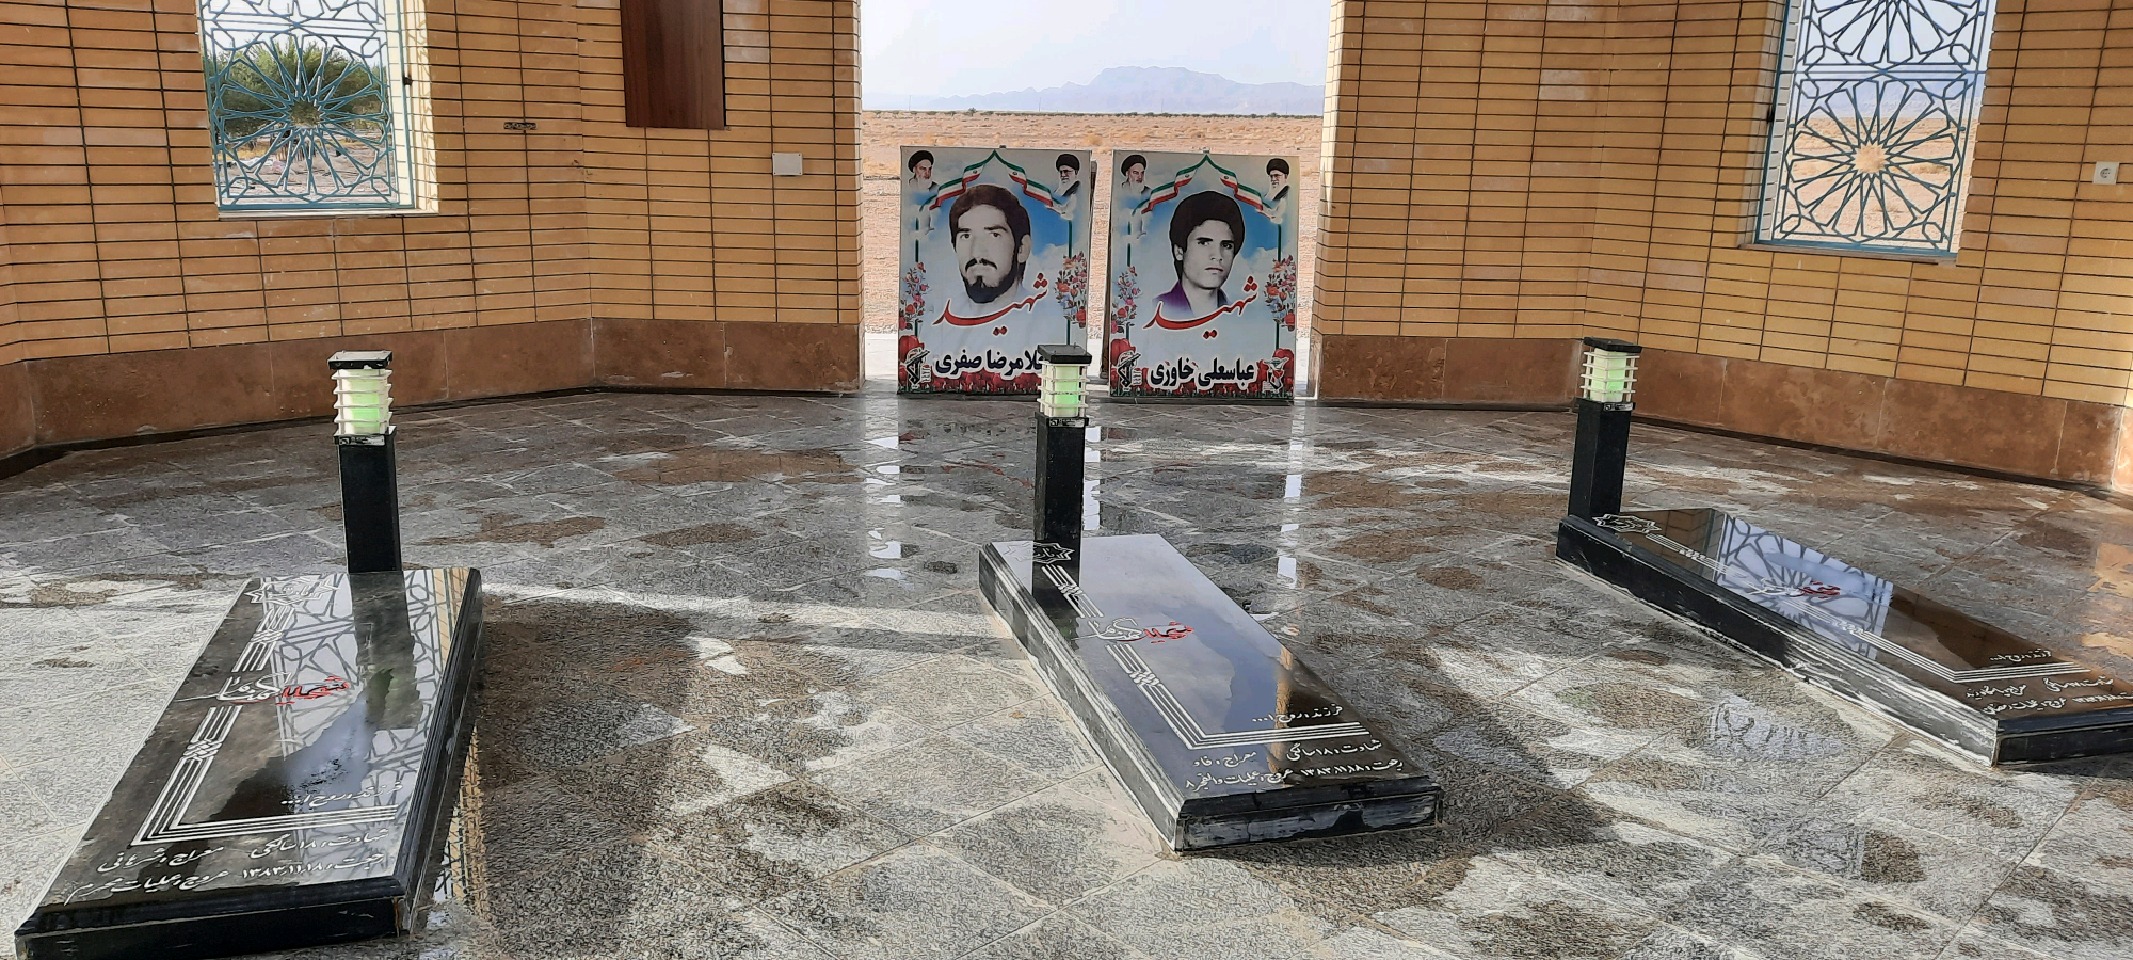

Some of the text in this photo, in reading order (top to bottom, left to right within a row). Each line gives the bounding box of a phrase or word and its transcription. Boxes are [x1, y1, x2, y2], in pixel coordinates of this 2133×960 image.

[932, 273, 1048, 336] شهید
[1143, 275, 1258, 339] شهید
[935, 349, 1043, 376] لامرضا صفری
[1199, 357, 1255, 386] عباسعلی
[1142, 620, 1195, 643] شهید
[1193, 755, 1213, 767] فاو
